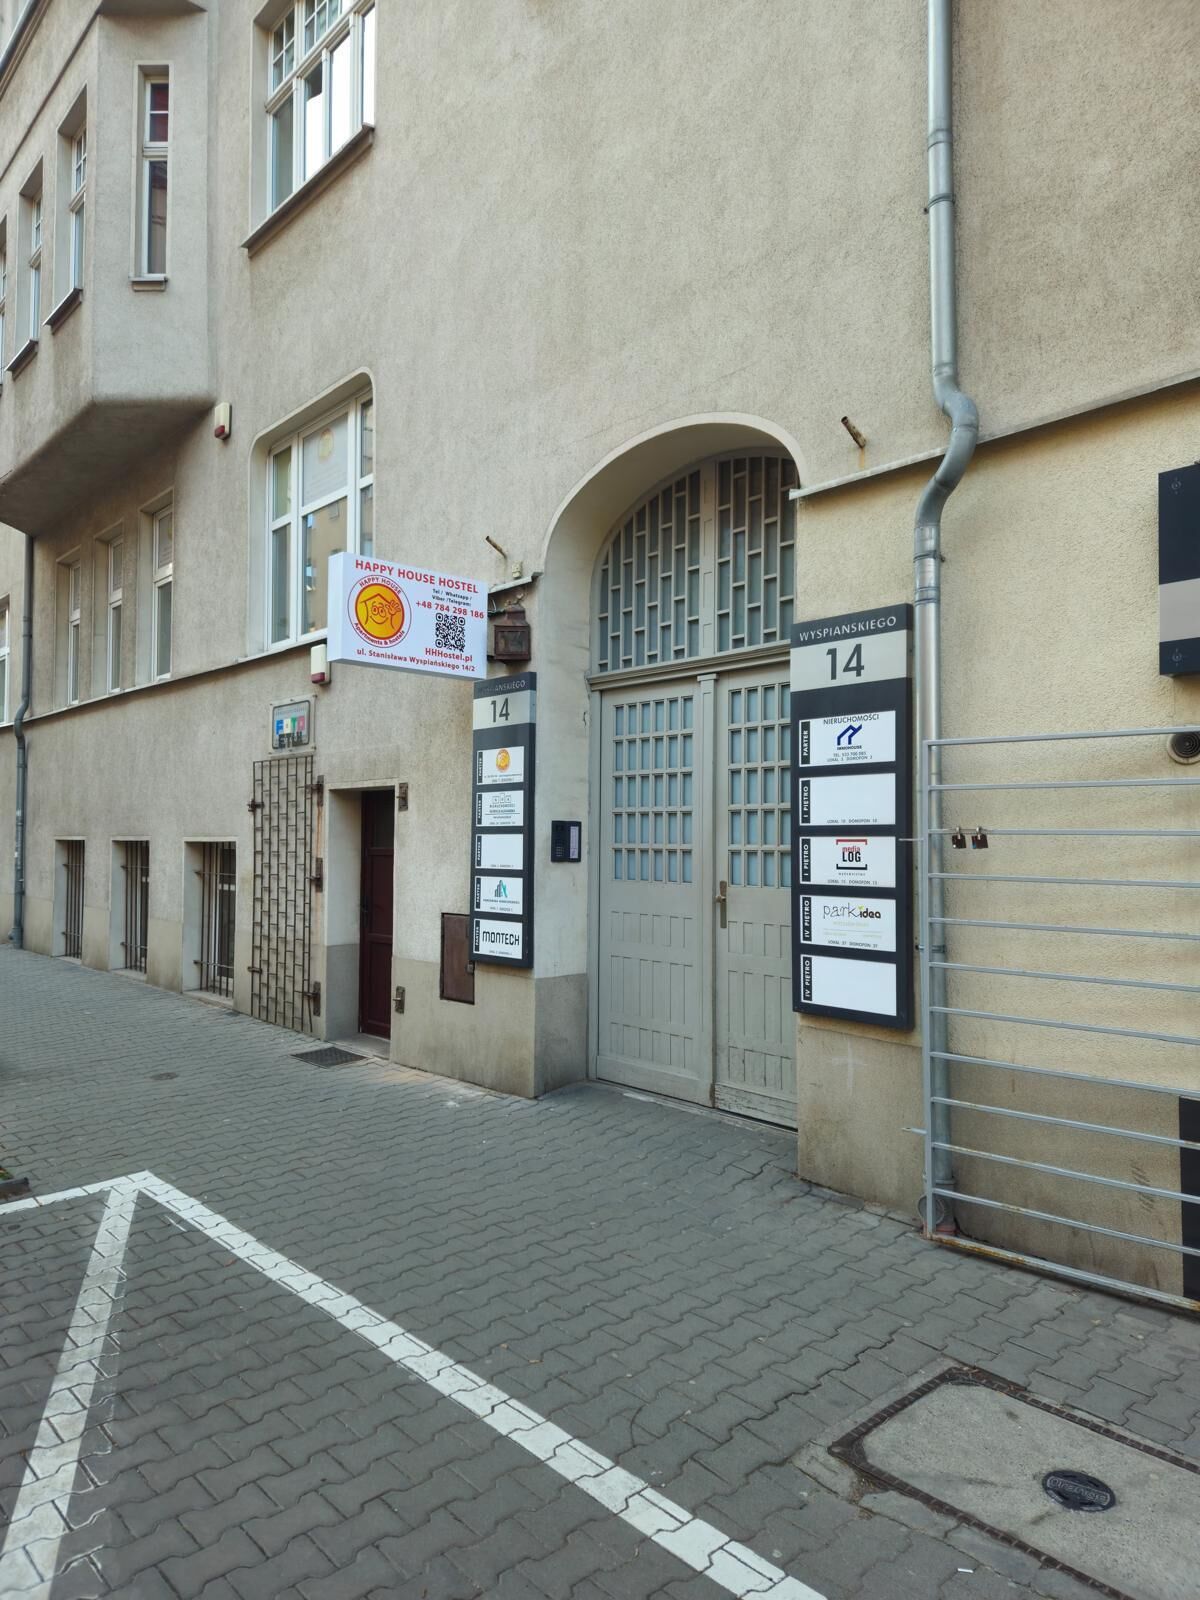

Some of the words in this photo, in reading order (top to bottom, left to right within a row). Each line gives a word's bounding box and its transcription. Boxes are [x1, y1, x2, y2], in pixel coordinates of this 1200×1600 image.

[355, 560, 394, 575] HAPPY
[398, 569, 435, 584] HOUSE
[439, 578, 479, 593] HOSTEL
[359, 578, 380, 588] HAPPY
[381, 578, 402, 595] HOUSE
[416, 600, 432, 609] +48
[435, 603, 450, 612] 784
[453, 606, 468, 616] 298
[470, 609, 484, 619] 186
[354, 622, 383, 646] Apartments
[389, 630, 405, 645] hostels
[799, 616, 896, 642] WYSPIANSKIEGO
[357, 648, 367, 656] ul.
[368, 650, 407, 662] Stanisława
[461, 664, 476, 672] 14/2
[425, 647, 473, 662] HHHostel.pl
[826, 643, 865, 681] 14
[490, 697, 510, 723] 14
[823, 713, 880, 725] NIERUCHOMOŚCI
[841, 845, 861, 853] media
[842, 851, 861, 863] LOG
[804, 930, 810, 938] IV
[804, 989, 811, 997] IV
